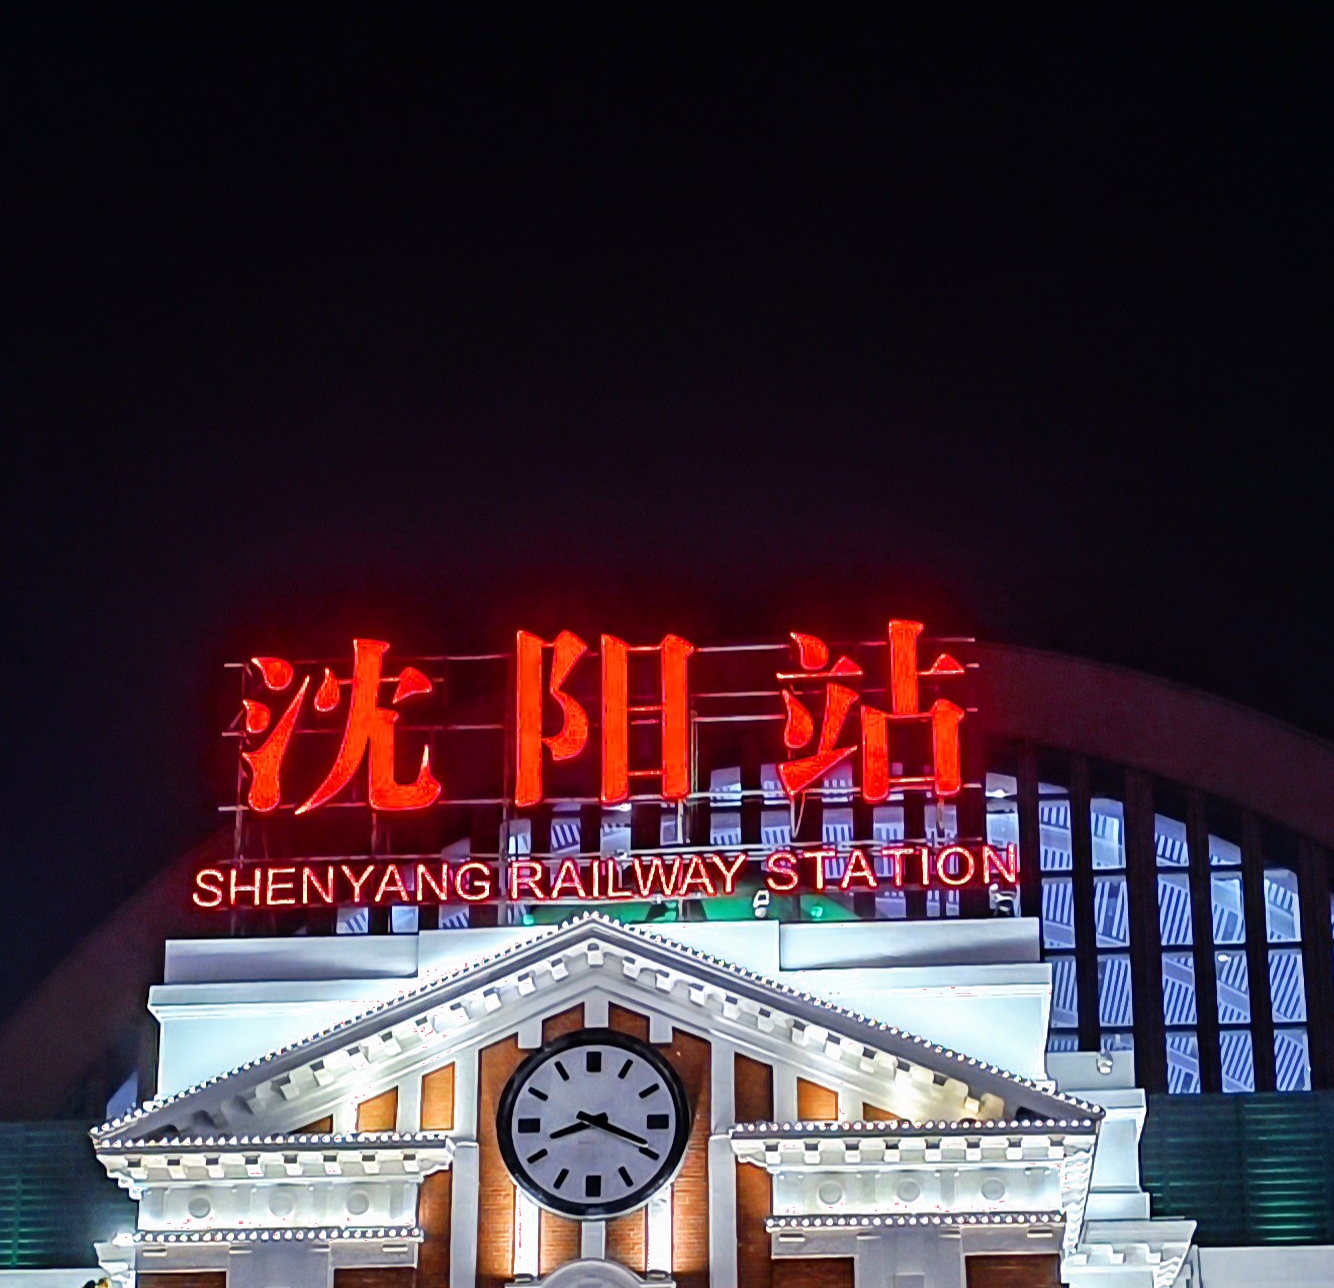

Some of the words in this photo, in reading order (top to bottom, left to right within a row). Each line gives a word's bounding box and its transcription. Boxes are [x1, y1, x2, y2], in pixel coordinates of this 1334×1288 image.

[244, 620, 965, 814] 沈阳站
[192, 862, 492, 907] SHENYANG
[510, 853, 748, 901] RAILWAY
[766, 843, 1018, 892] STATION
